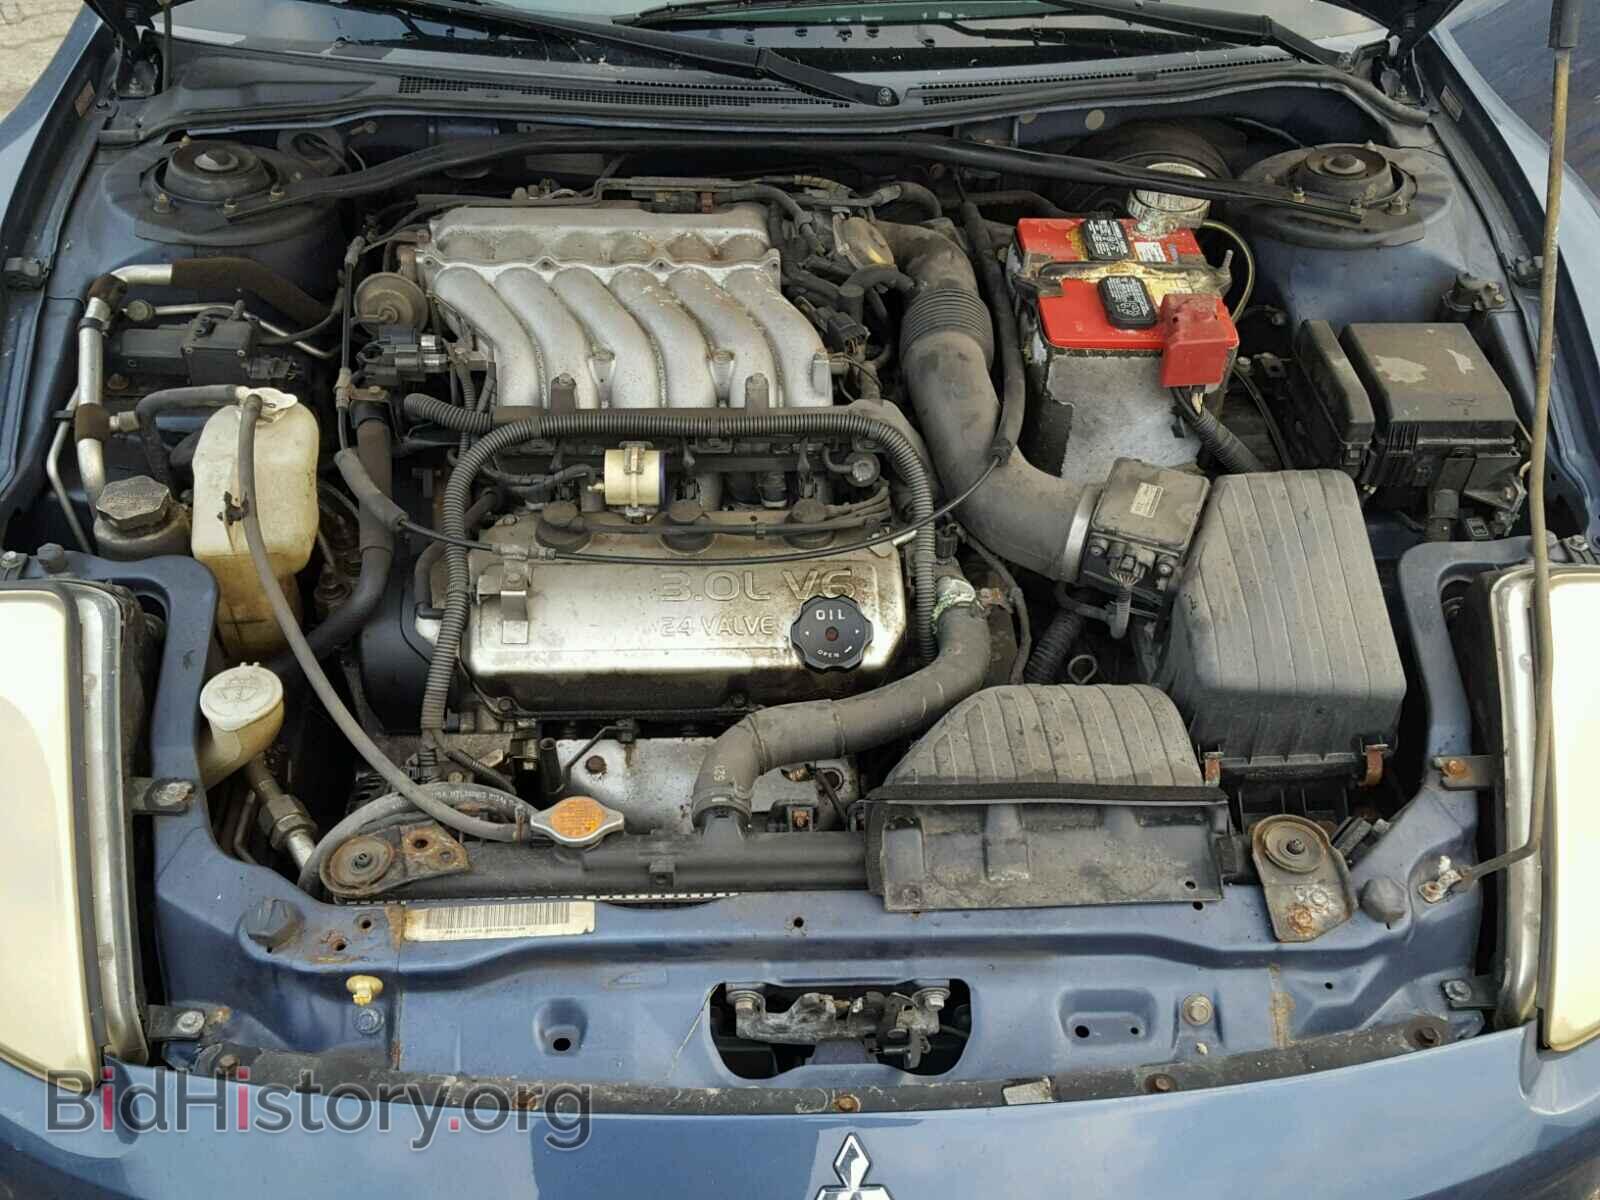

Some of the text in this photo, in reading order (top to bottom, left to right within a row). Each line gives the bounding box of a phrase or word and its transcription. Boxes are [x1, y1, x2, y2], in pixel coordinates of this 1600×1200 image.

[660, 569, 857, 601] 3.0L V6
[815, 608, 846, 620] OIL
[661, 616, 774, 637] 24 VALVE
[817, 649, 840, 658] OPEN
